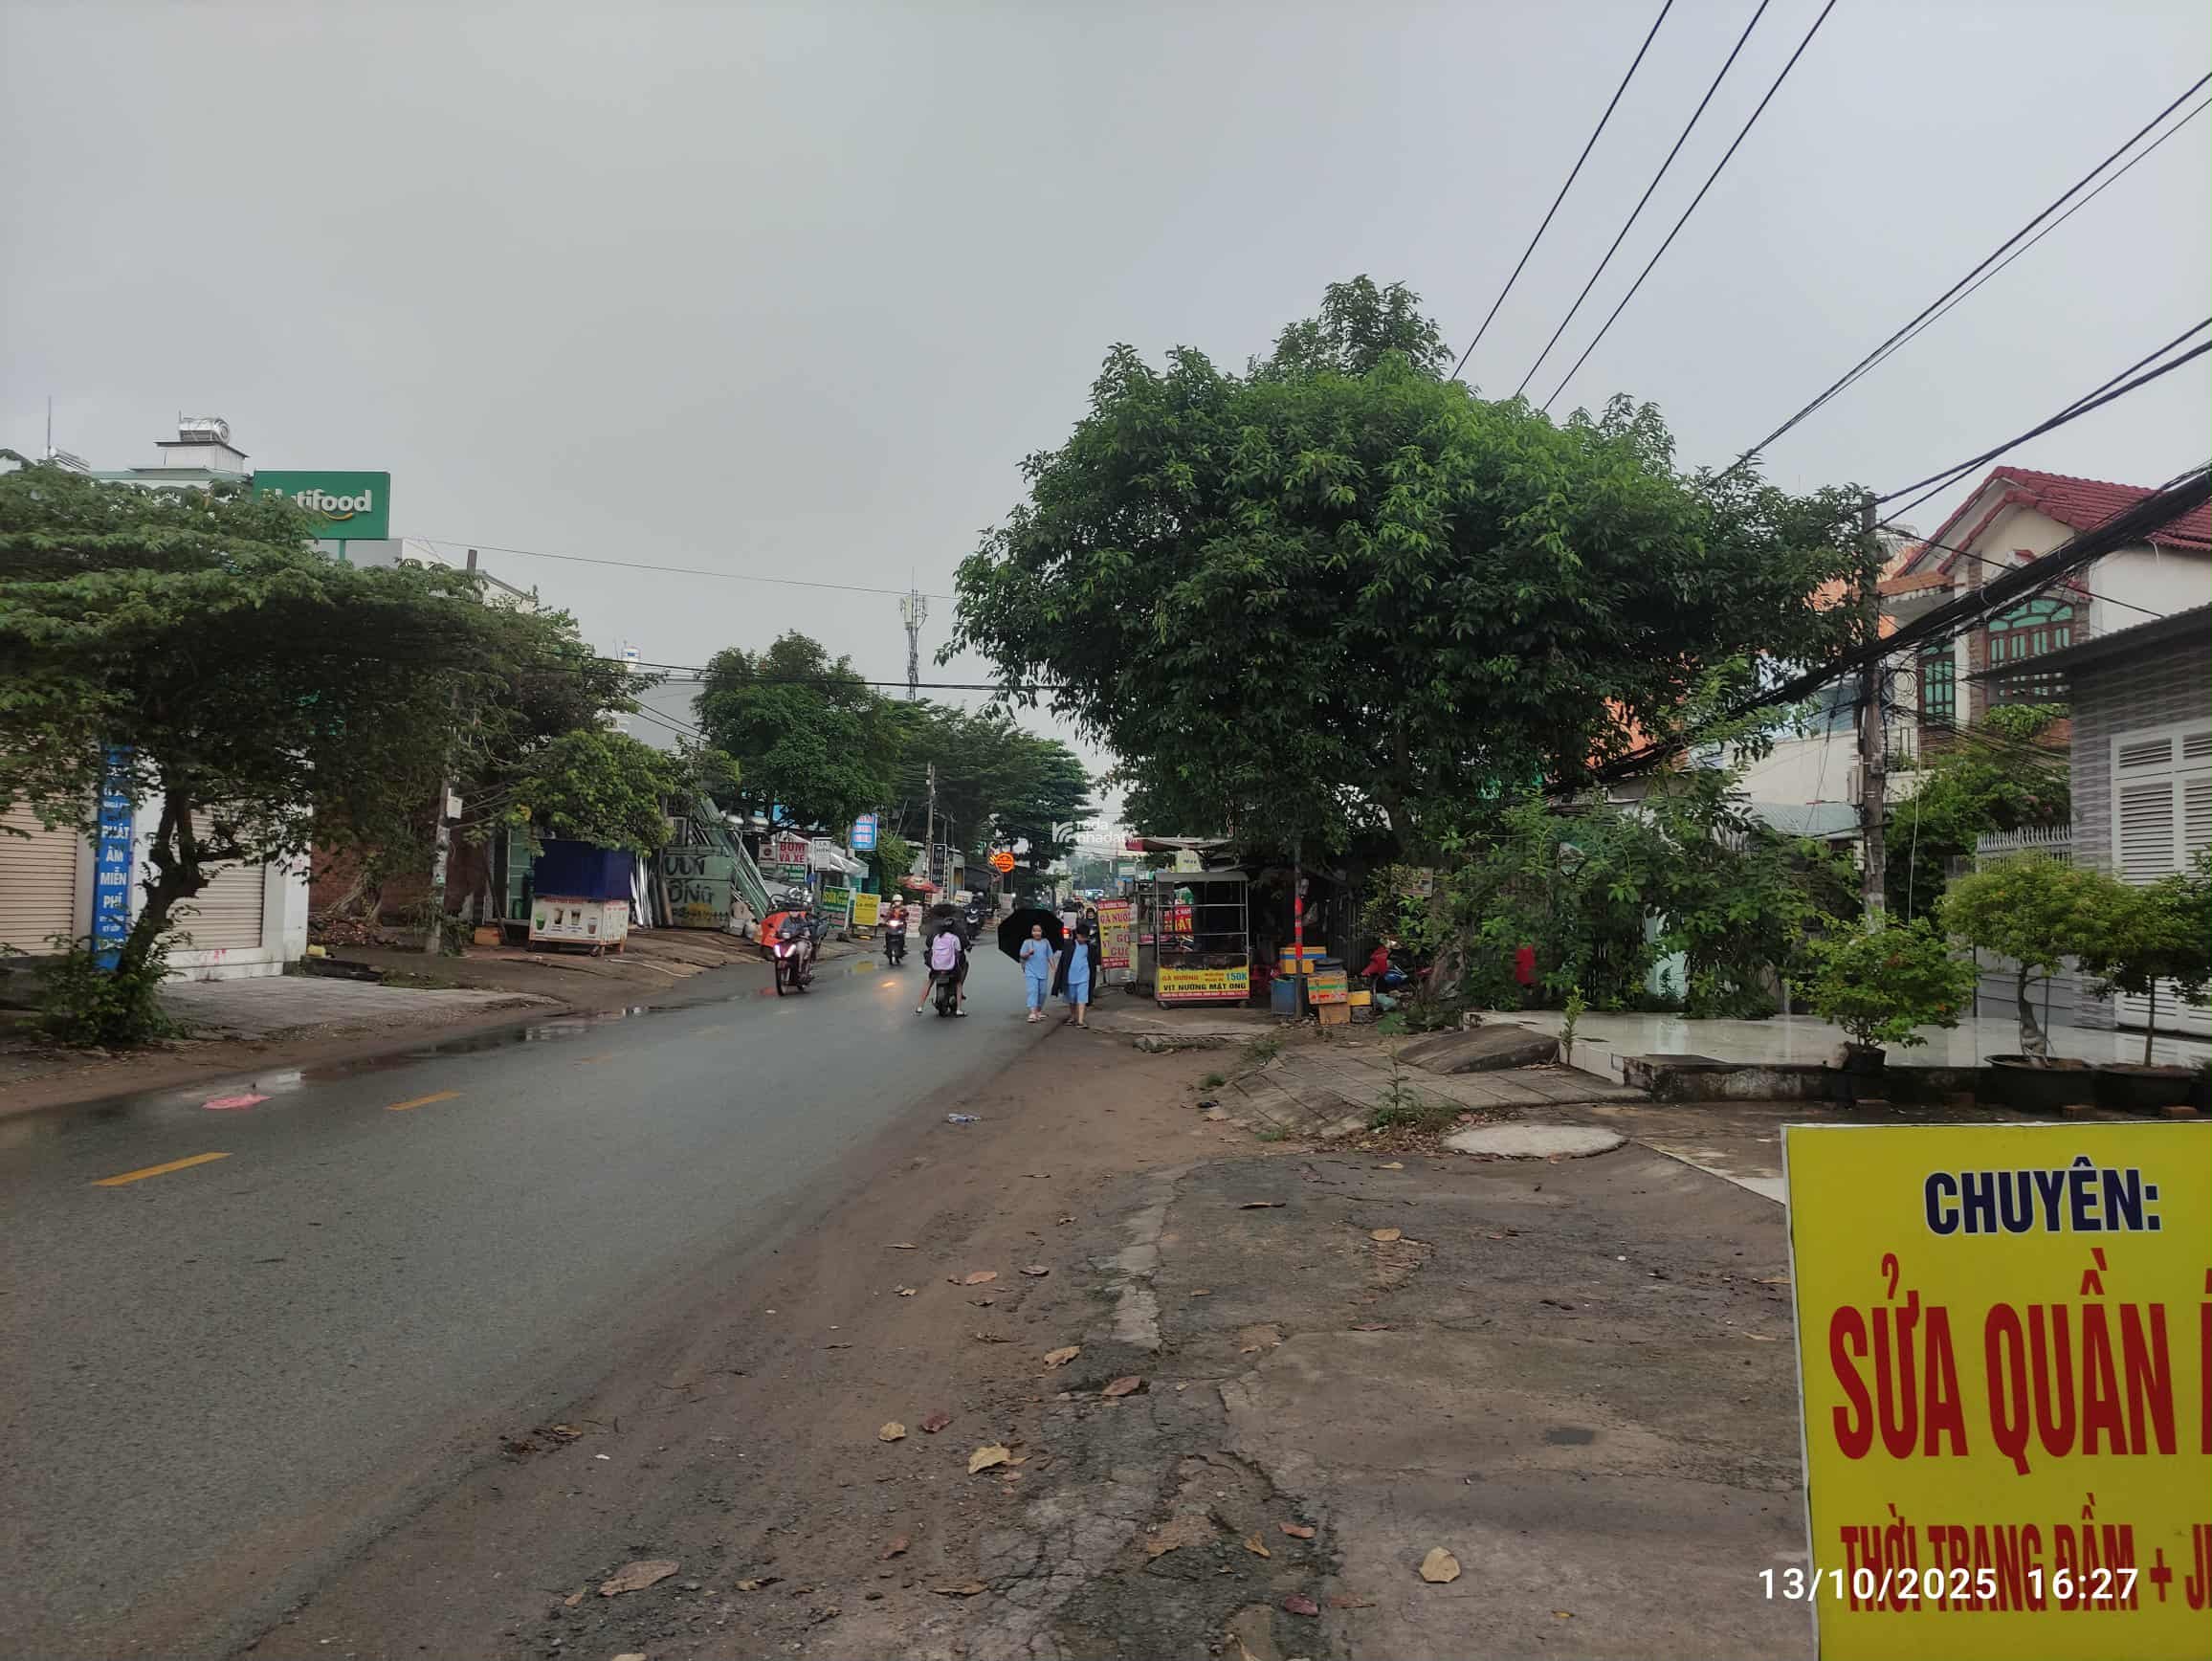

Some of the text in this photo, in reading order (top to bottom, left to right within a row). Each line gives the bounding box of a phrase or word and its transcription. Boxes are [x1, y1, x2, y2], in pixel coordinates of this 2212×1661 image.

[261, 488, 372, 513] tifood
[105, 846, 124, 862] ÂM
[100, 867, 127, 885] MIỄN
[103, 892, 123, 909] PHÍ
[1925, 1155, 2162, 1234] CHUYÊN:
[1829, 1252, 1968, 1460] SỬA
[1983, 1247, 2177, 1476] QUẦN
[1840, 1502, 1921, 1613] THỜI
[1927, 1523, 2047, 1613] TRANG
[2053, 1492, 2139, 1612] ĐẦM
